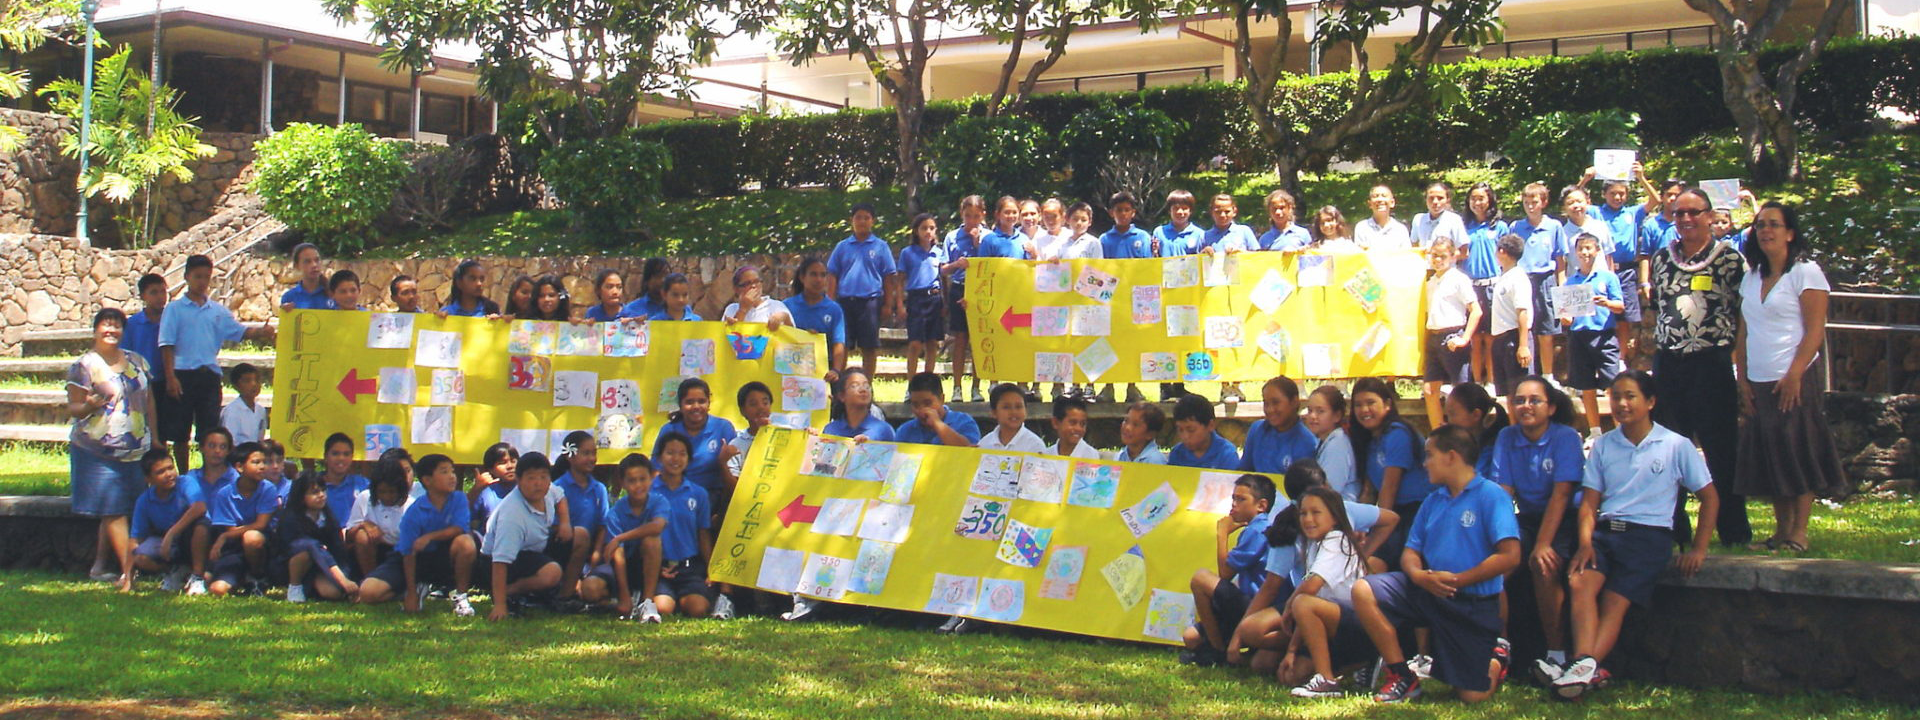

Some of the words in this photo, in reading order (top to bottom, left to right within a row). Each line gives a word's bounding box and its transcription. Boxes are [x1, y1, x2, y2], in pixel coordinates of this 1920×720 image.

[1187, 359, 1210, 371] 350
[286, 311, 321, 454] PIKO
[962, 506, 1006, 535] 350
[821, 556, 841, 567] 350
